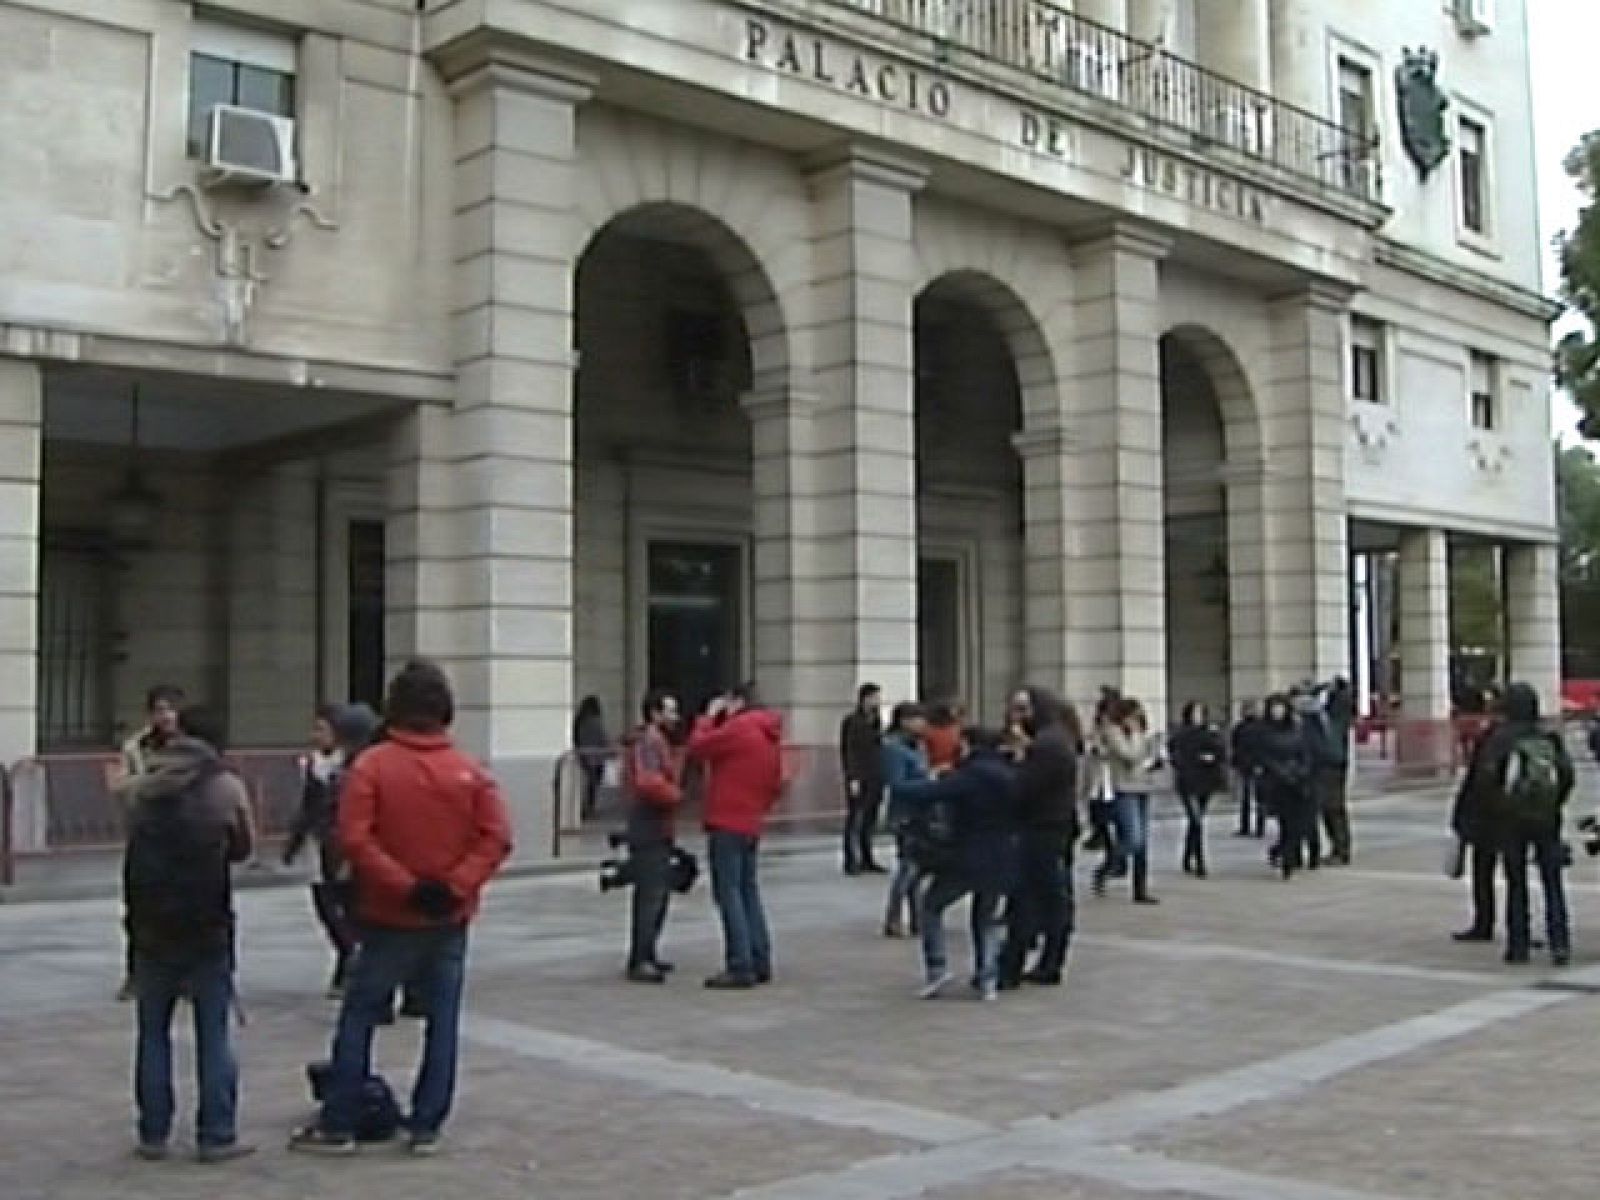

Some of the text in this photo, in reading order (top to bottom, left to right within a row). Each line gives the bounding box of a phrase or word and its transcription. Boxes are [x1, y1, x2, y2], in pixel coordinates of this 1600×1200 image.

[747, 19, 1264, 222] PALACIO DE JUSTICIA
